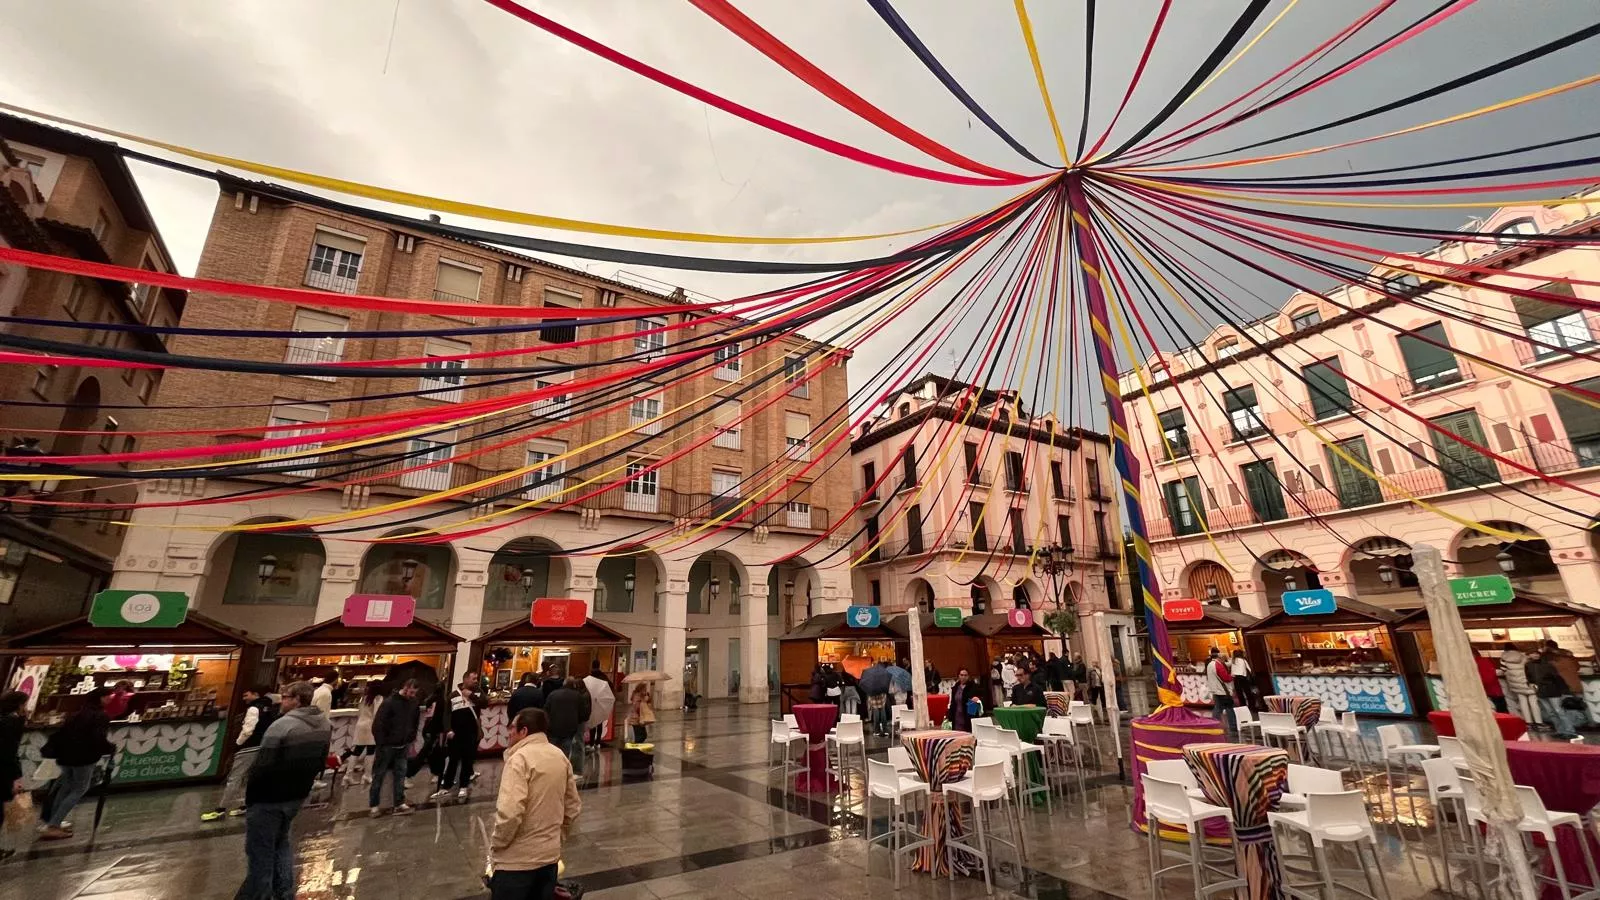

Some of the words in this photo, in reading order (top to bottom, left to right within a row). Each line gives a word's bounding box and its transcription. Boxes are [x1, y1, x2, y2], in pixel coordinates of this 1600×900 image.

[1468, 580, 1478, 589] Z
[123, 755, 176, 765] Huesca
[120, 768, 137, 778] es
[140, 765, 180, 776] dulce
